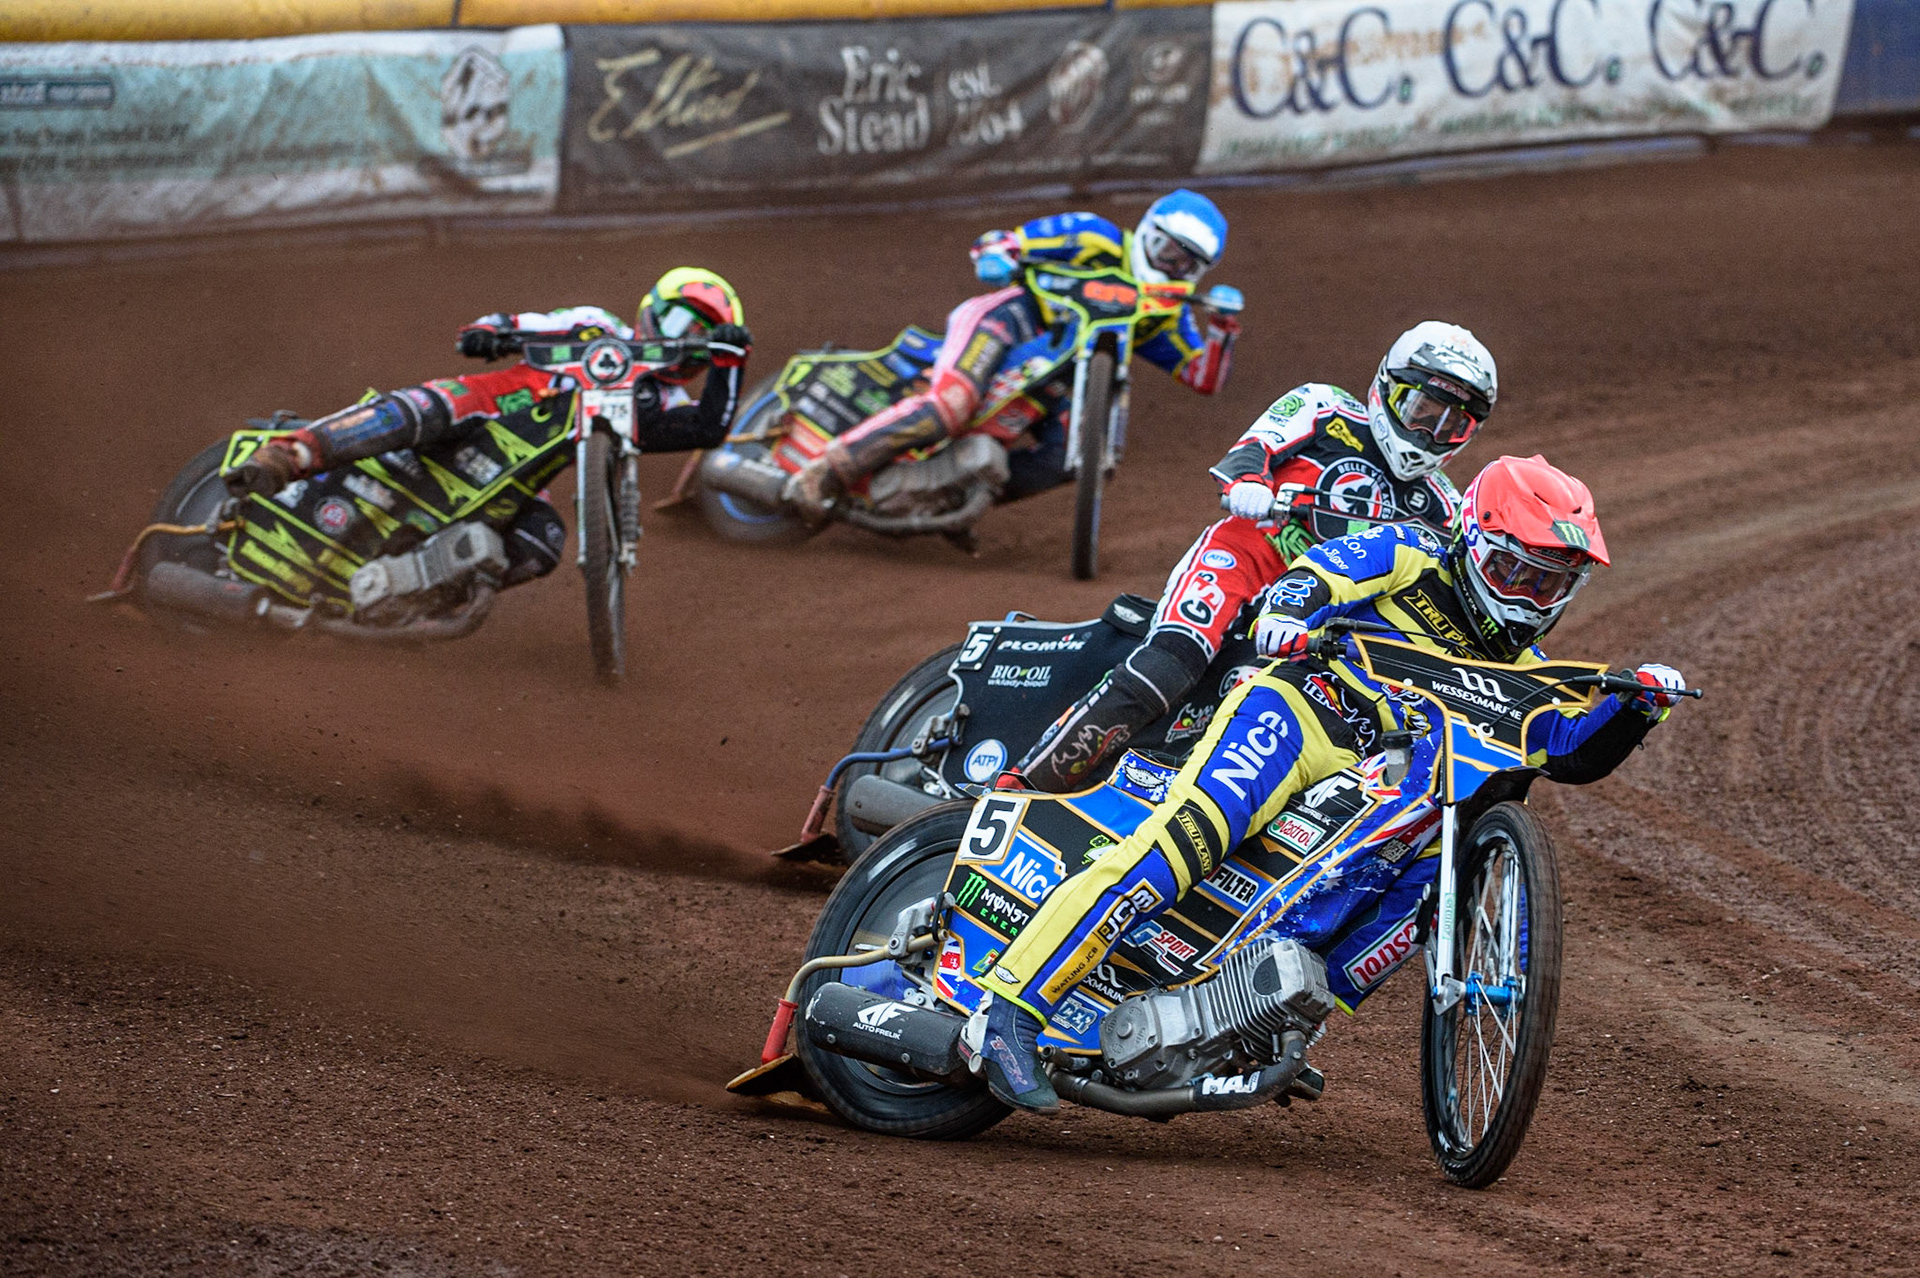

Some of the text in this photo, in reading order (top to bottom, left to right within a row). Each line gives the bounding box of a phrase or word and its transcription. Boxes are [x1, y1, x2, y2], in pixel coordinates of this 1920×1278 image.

[841, 45, 922, 102] Eric
[817, 93, 931, 154] Stead
[1337, 462, 1367, 474] BELLE
[1414, 596, 1448, 631] TRU
[959, 633, 995, 663] 5
[997, 639, 1087, 652] PLOMYK
[972, 754, 999, 768] ATPI
[1210, 710, 1289, 801] Nice
[969, 799, 1016, 856] 5
[1180, 814, 1200, 838] TRU
[1279, 819, 1315, 847] Castrol
[1209, 866, 1259, 907] FILTER
[1105, 889, 1155, 941] JCB
[1155, 930, 1196, 959] SPORT
[1052, 946, 1098, 994] WATLING JCB
[853, 1021, 901, 1040] AUTO FRELIK
